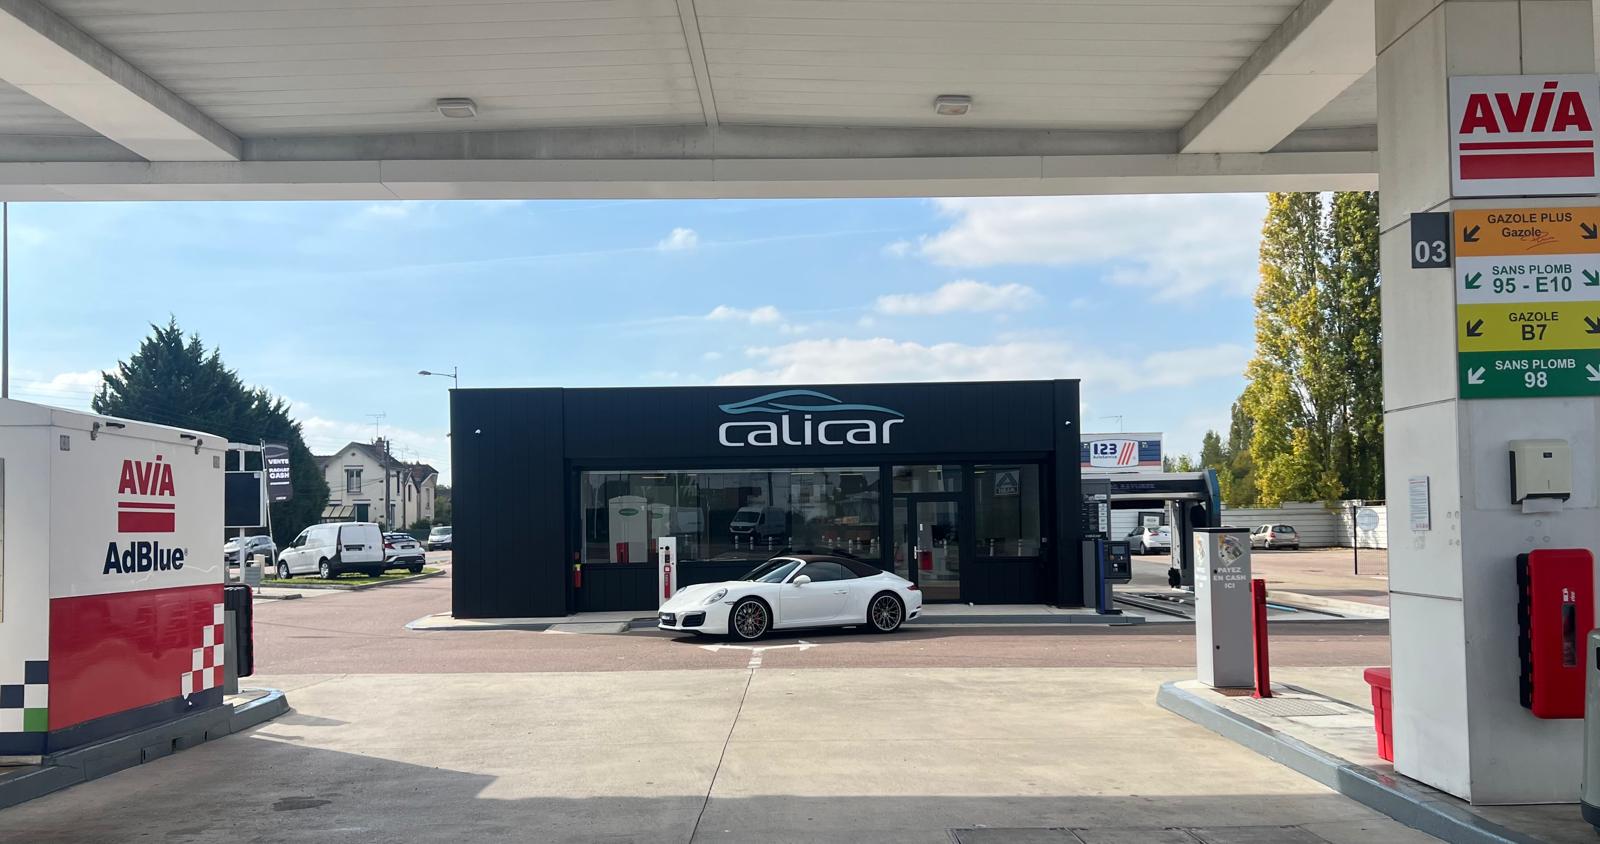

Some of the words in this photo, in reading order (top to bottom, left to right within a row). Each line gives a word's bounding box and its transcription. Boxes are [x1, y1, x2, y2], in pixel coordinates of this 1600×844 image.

[1487, 213, 1538, 225] GAZOLE
[1540, 212, 1573, 223] PLUS
[1501, 226, 1542, 238] Gazole
[1415, 240, 1447, 263] 03
[1492, 264, 1526, 275] SANS
[1529, 263, 1572, 275] PLOMB
[1493, 277, 1517, 294] 95
[1535, 275, 1572, 293] E10
[1508, 311, 1559, 322] GAZOLE
[1521, 324, 1547, 341] B7
[1495, 359, 1529, 370] SANS
[1532, 358, 1576, 370] PLOMB
[1524, 371, 1548, 388] 98
[718, 414, 904, 447] calicar
